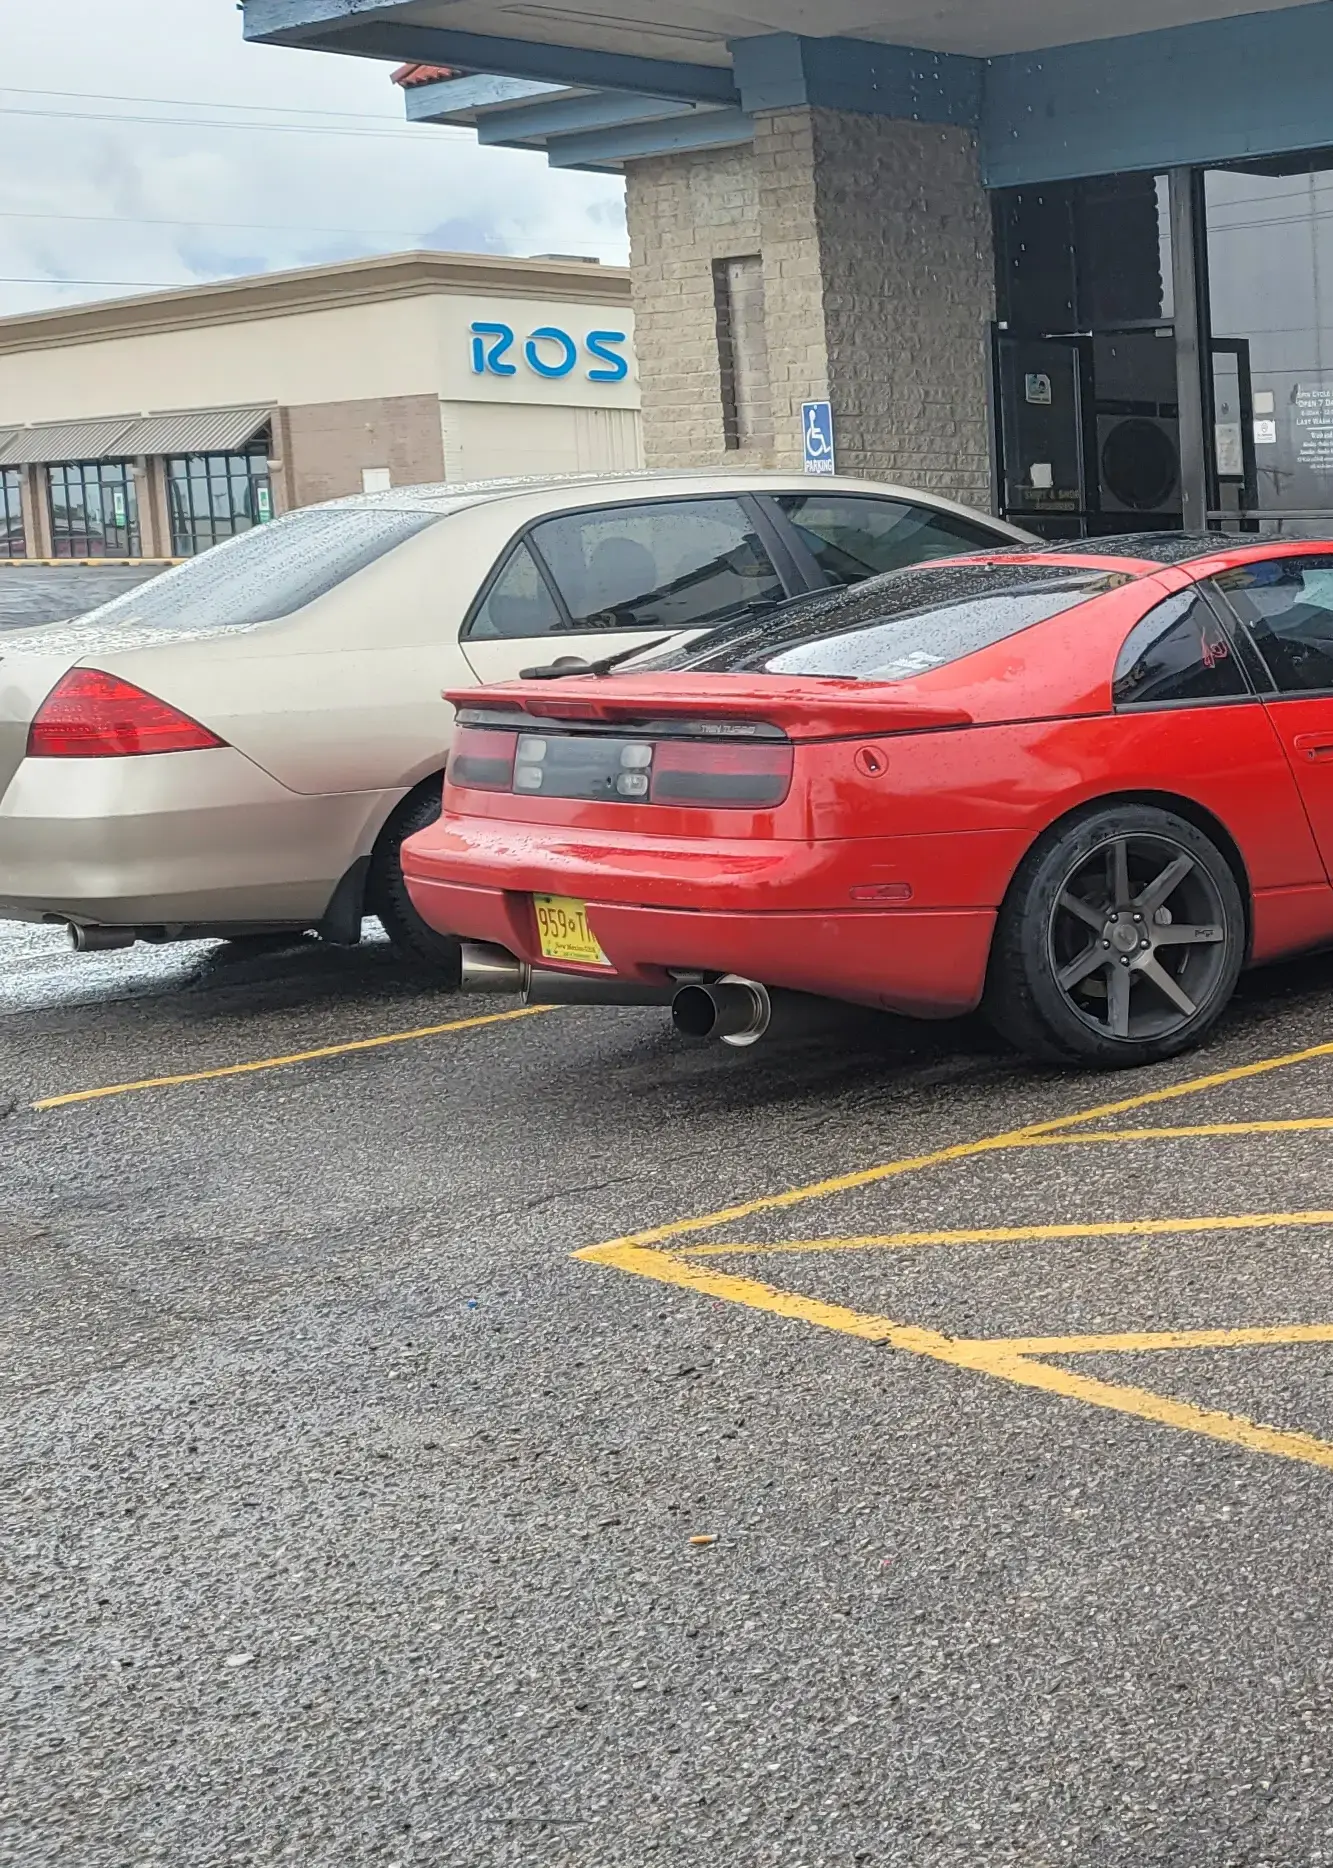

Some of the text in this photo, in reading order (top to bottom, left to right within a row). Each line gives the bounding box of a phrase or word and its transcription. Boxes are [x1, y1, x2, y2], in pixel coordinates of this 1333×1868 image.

[470, 321, 629, 382] ROS
[805, 459, 832, 474] PARKING
[538, 907, 567, 939] 959
